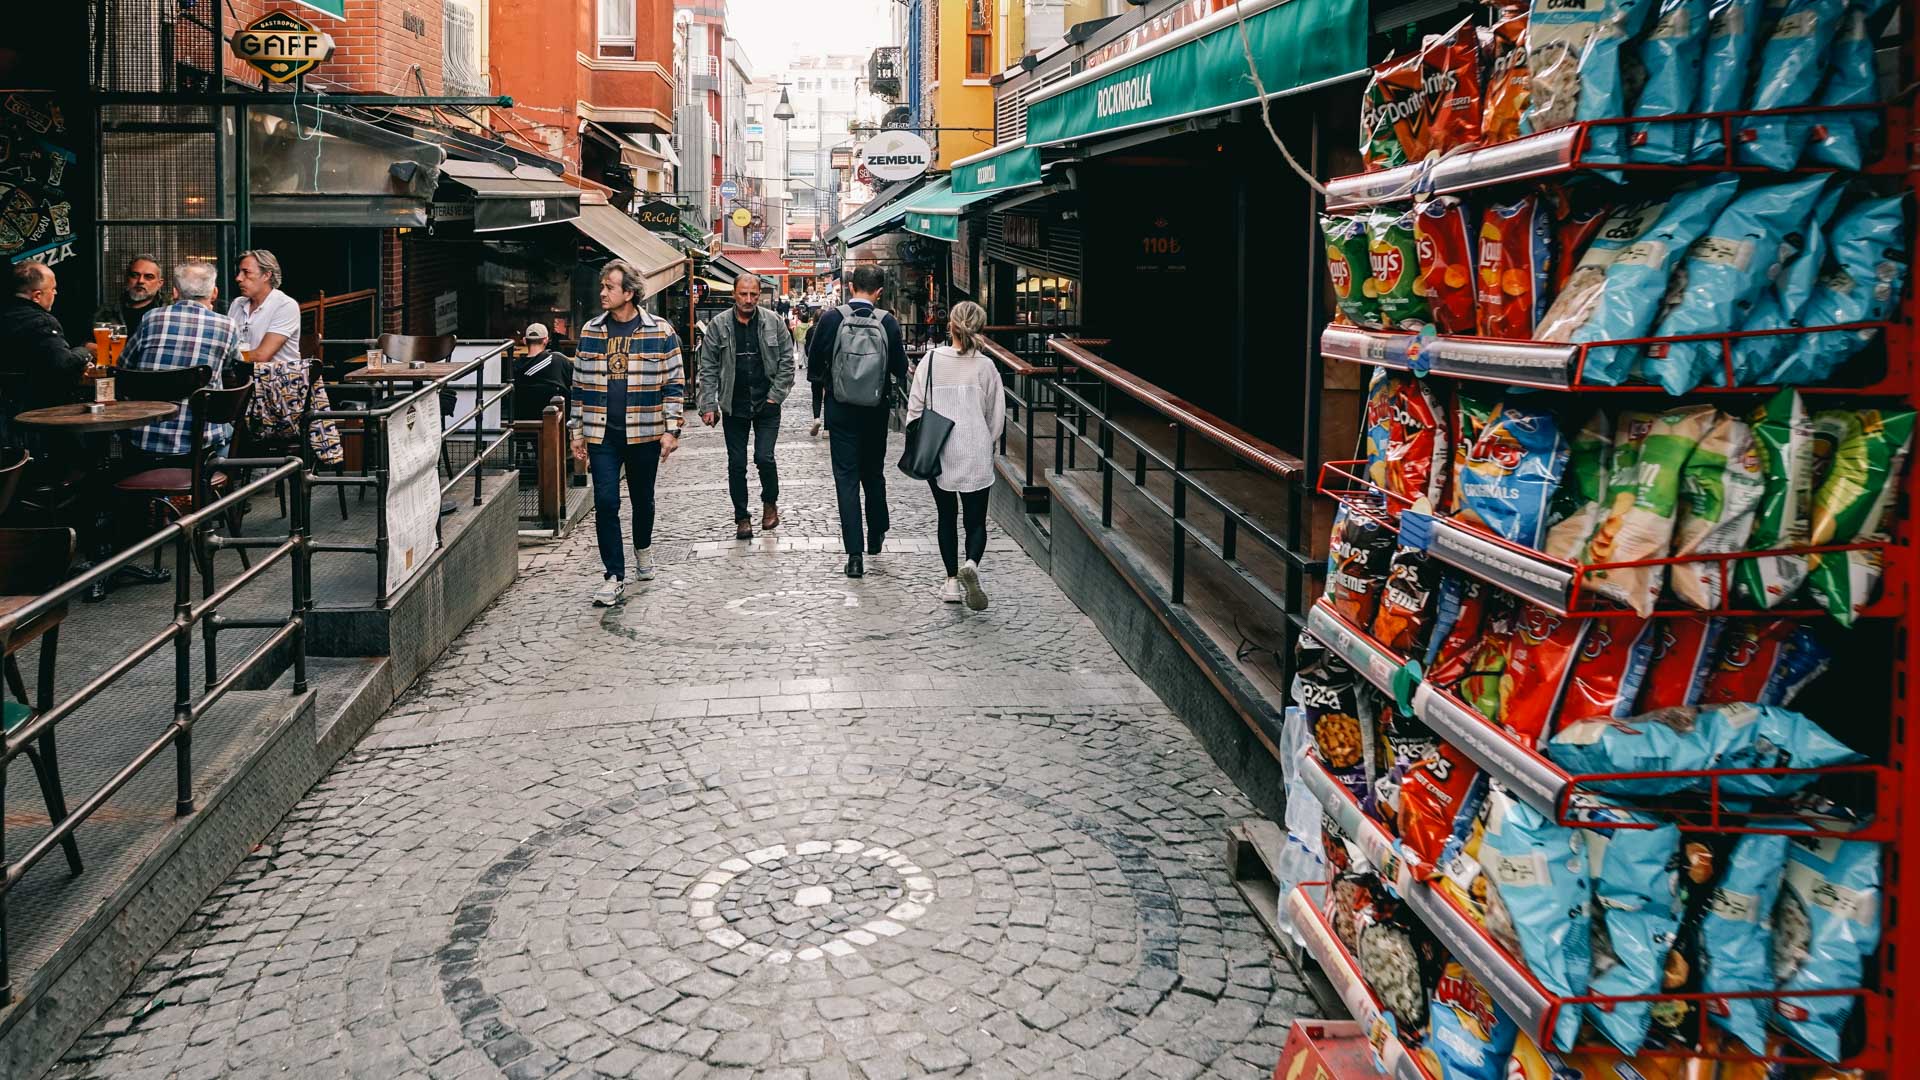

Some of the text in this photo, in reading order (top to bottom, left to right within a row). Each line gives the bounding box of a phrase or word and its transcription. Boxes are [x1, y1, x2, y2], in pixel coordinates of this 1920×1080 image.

[239, 34, 318, 56] GAFF
[1097, 73, 1153, 119] ROCKNROLLA
[867, 155, 926, 166] ZEMBUL
[29, 215, 52, 243] VEGAN
[641, 211, 678, 225] ReCafe
